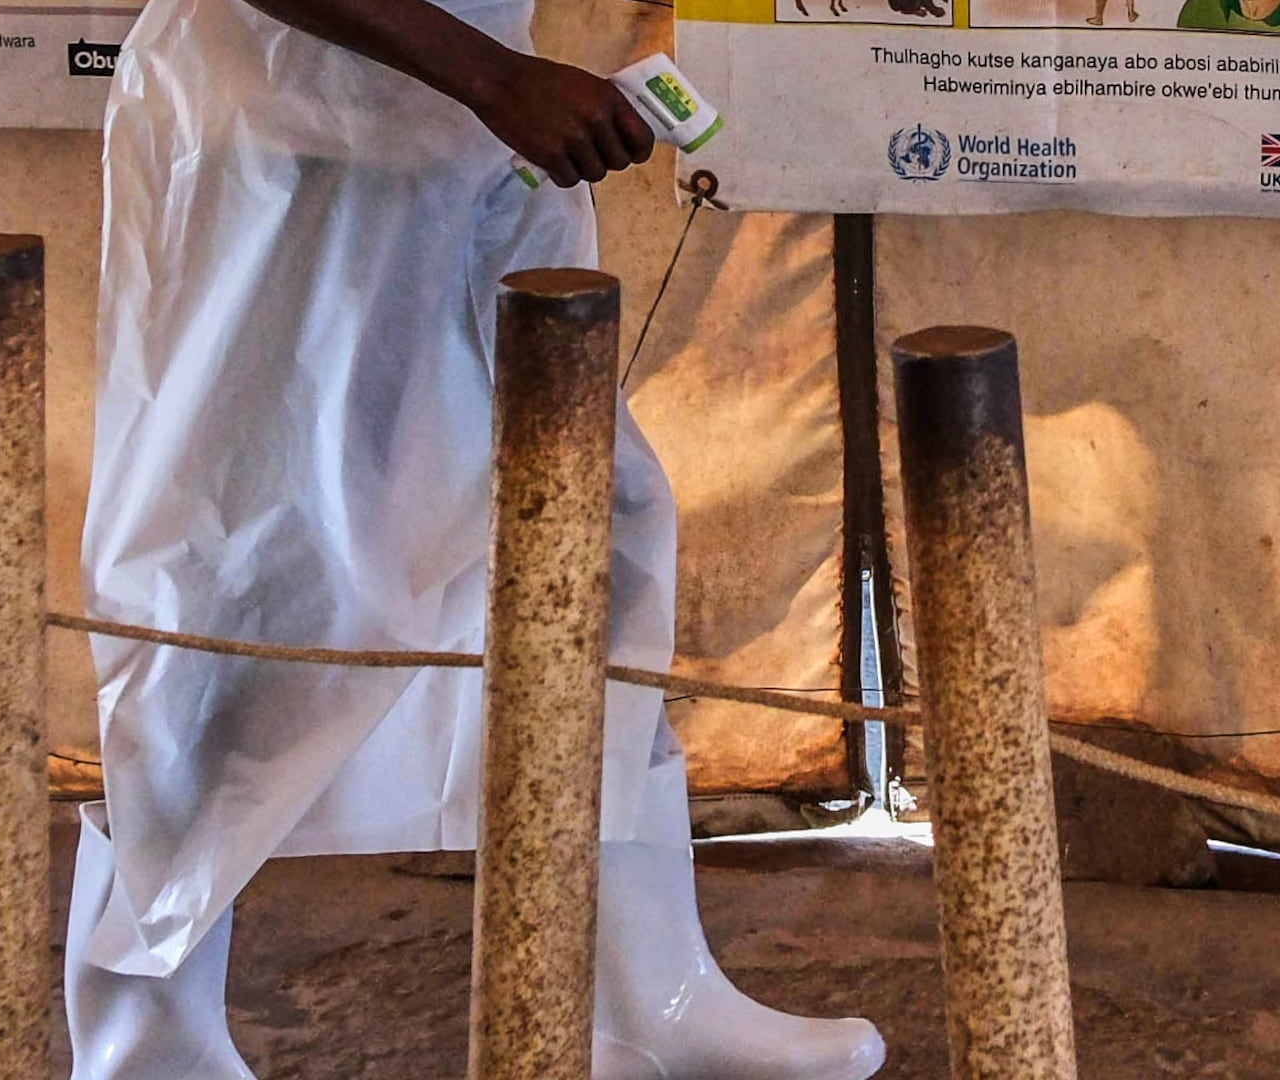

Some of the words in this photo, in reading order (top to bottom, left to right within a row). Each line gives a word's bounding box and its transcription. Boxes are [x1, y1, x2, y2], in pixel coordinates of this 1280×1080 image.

[870, 48, 963, 72] Thulhagho
[967, 50, 1016, 68] kutse
[1020, 52, 1120, 74] kanganaya
[1124, 54, 1159, 71] abo
[1163, 55, 1211, 72] abosi
[957, 135, 1011, 155] World
[1018, 136, 1077, 157] Health
[956, 157, 1077, 183] Organization
